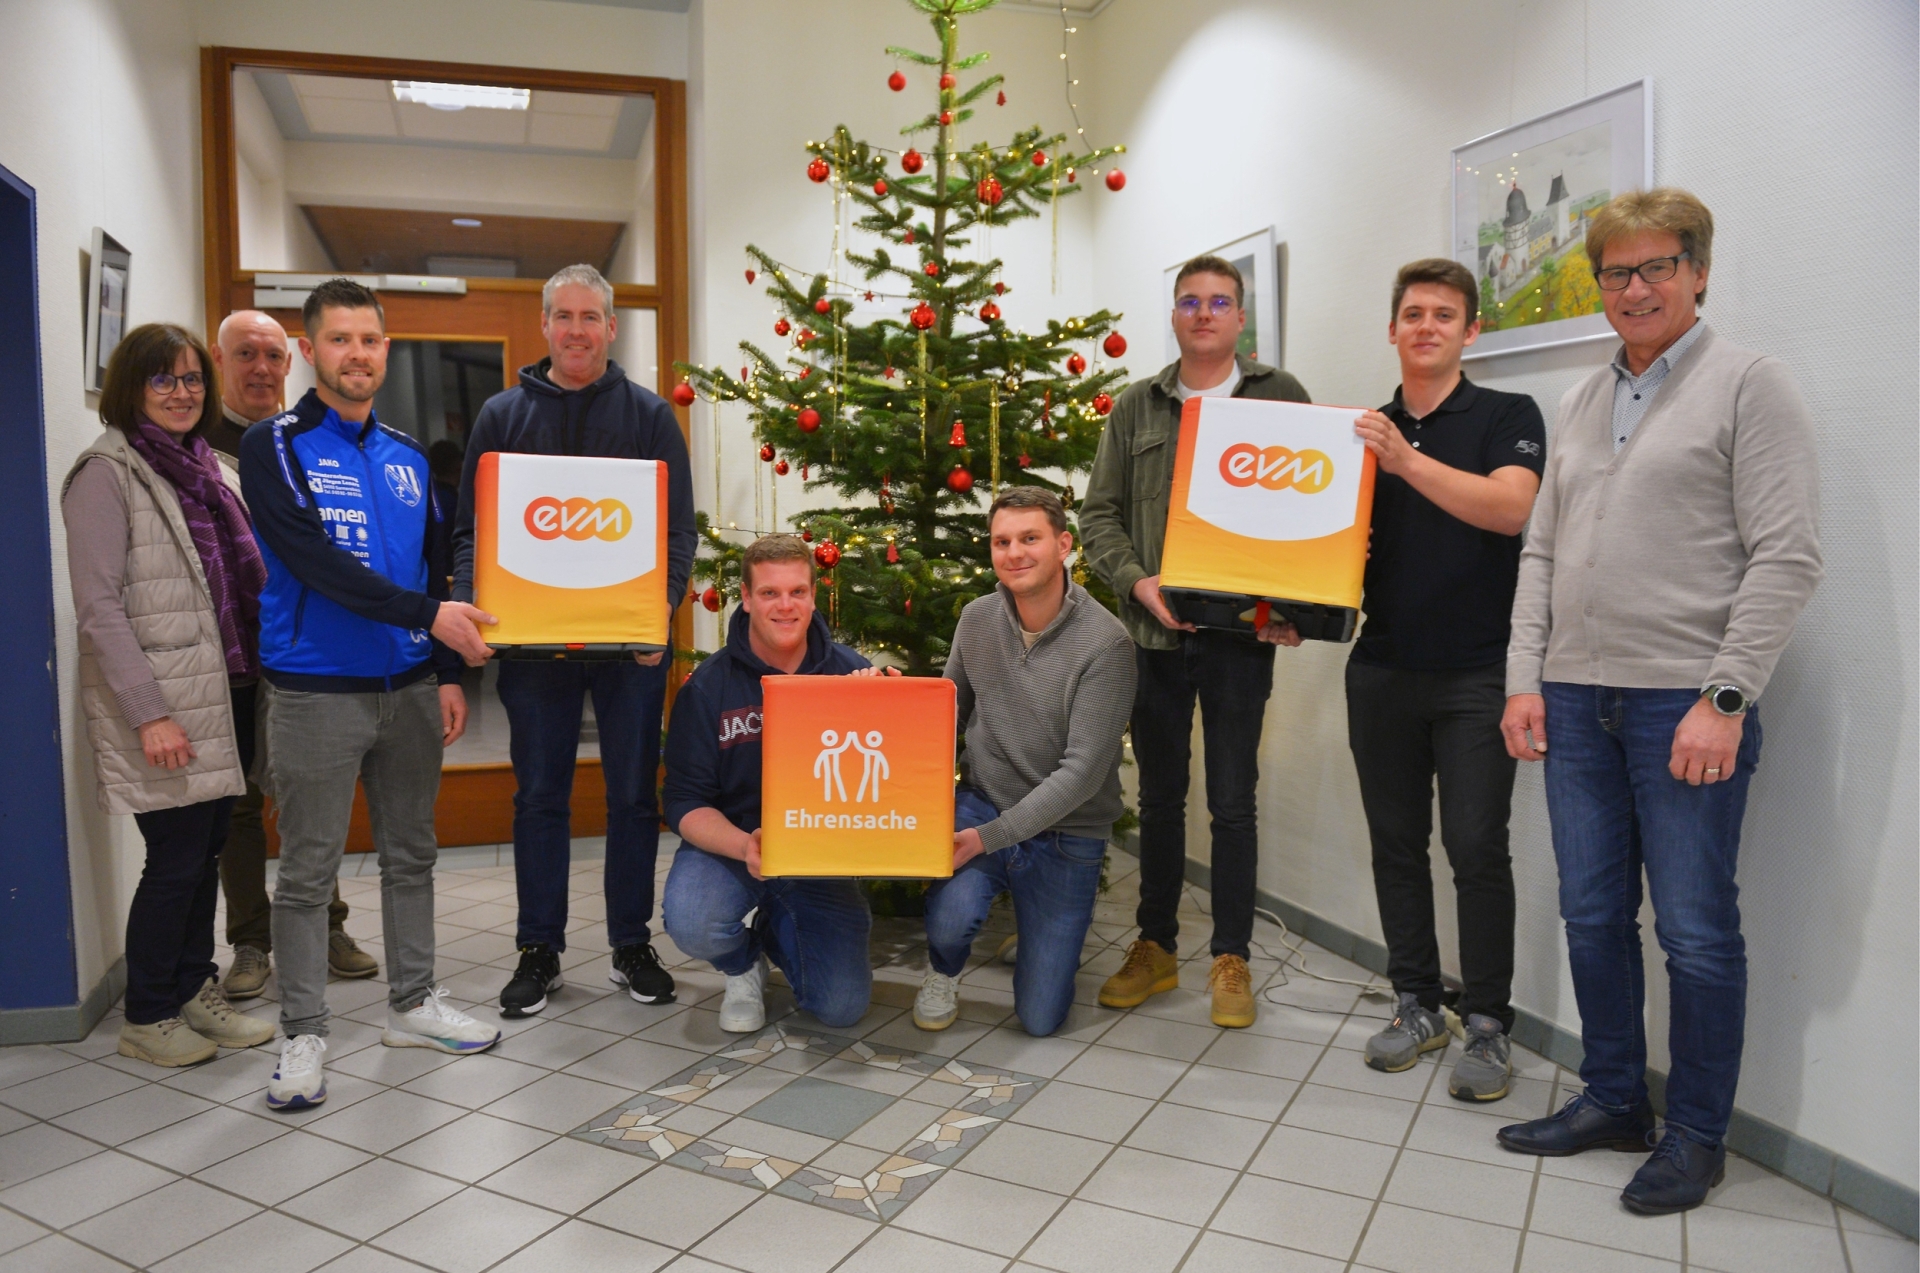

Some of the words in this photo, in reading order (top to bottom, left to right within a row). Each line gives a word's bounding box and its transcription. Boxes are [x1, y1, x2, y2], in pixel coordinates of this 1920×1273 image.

[318, 457, 341, 468] JAKO
[1227, 451, 1325, 486] evm
[532, 505, 623, 533] evm
[784, 808, 918, 831] Ehrensache
